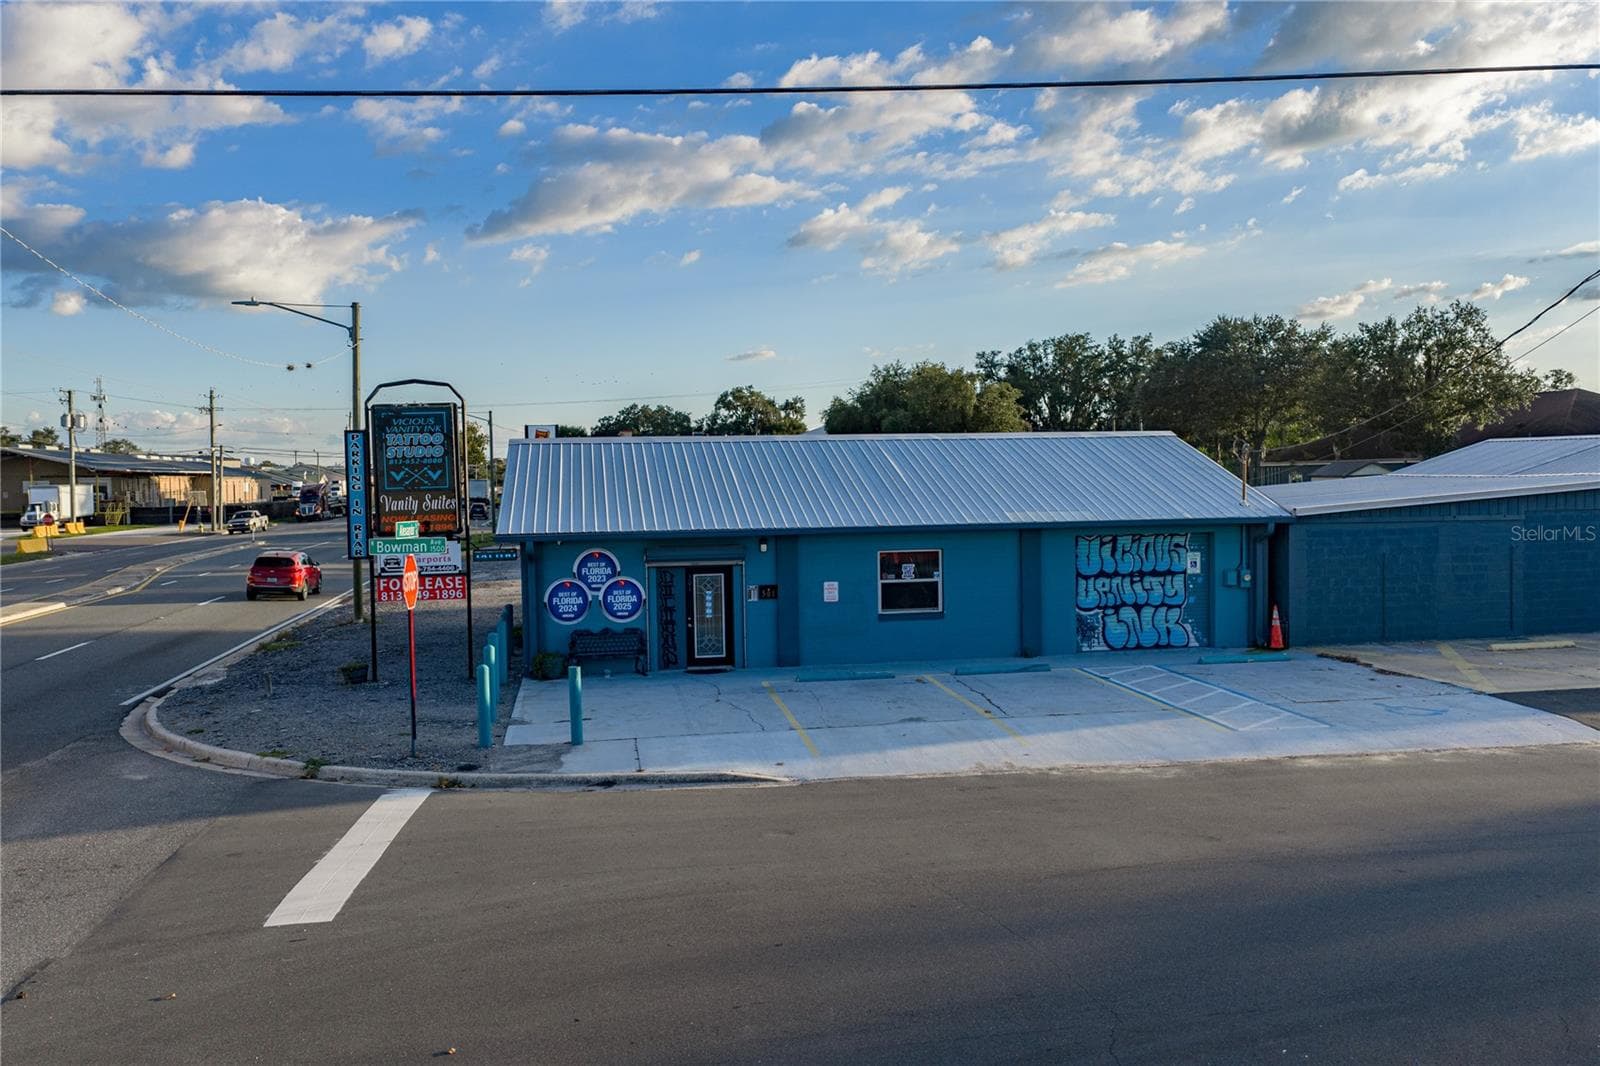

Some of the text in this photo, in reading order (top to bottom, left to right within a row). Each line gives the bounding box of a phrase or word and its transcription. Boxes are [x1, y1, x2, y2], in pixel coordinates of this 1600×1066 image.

[392, 416, 435, 425] VICIOUS
[385, 424, 442, 433] VANITY INK
[385, 432, 444, 446] TATTOO
[386, 445, 444, 459] STUDIO
[350, 432, 363, 558] PARKING IN REAR
[380, 493, 456, 514] Vanity Suites
[376, 541, 427, 553] Bowman
[417, 555, 452, 565] arports
[582, 567, 612, 575] FLORIDA
[587, 575, 607, 583] 2023
[380, 578, 401, 591] FO
[552, 596, 583, 605] FLORIDA
[607, 595, 638, 603] FLORIDA
[558, 604, 578, 612] 2024
[613, 603, 632, 611] 2025
